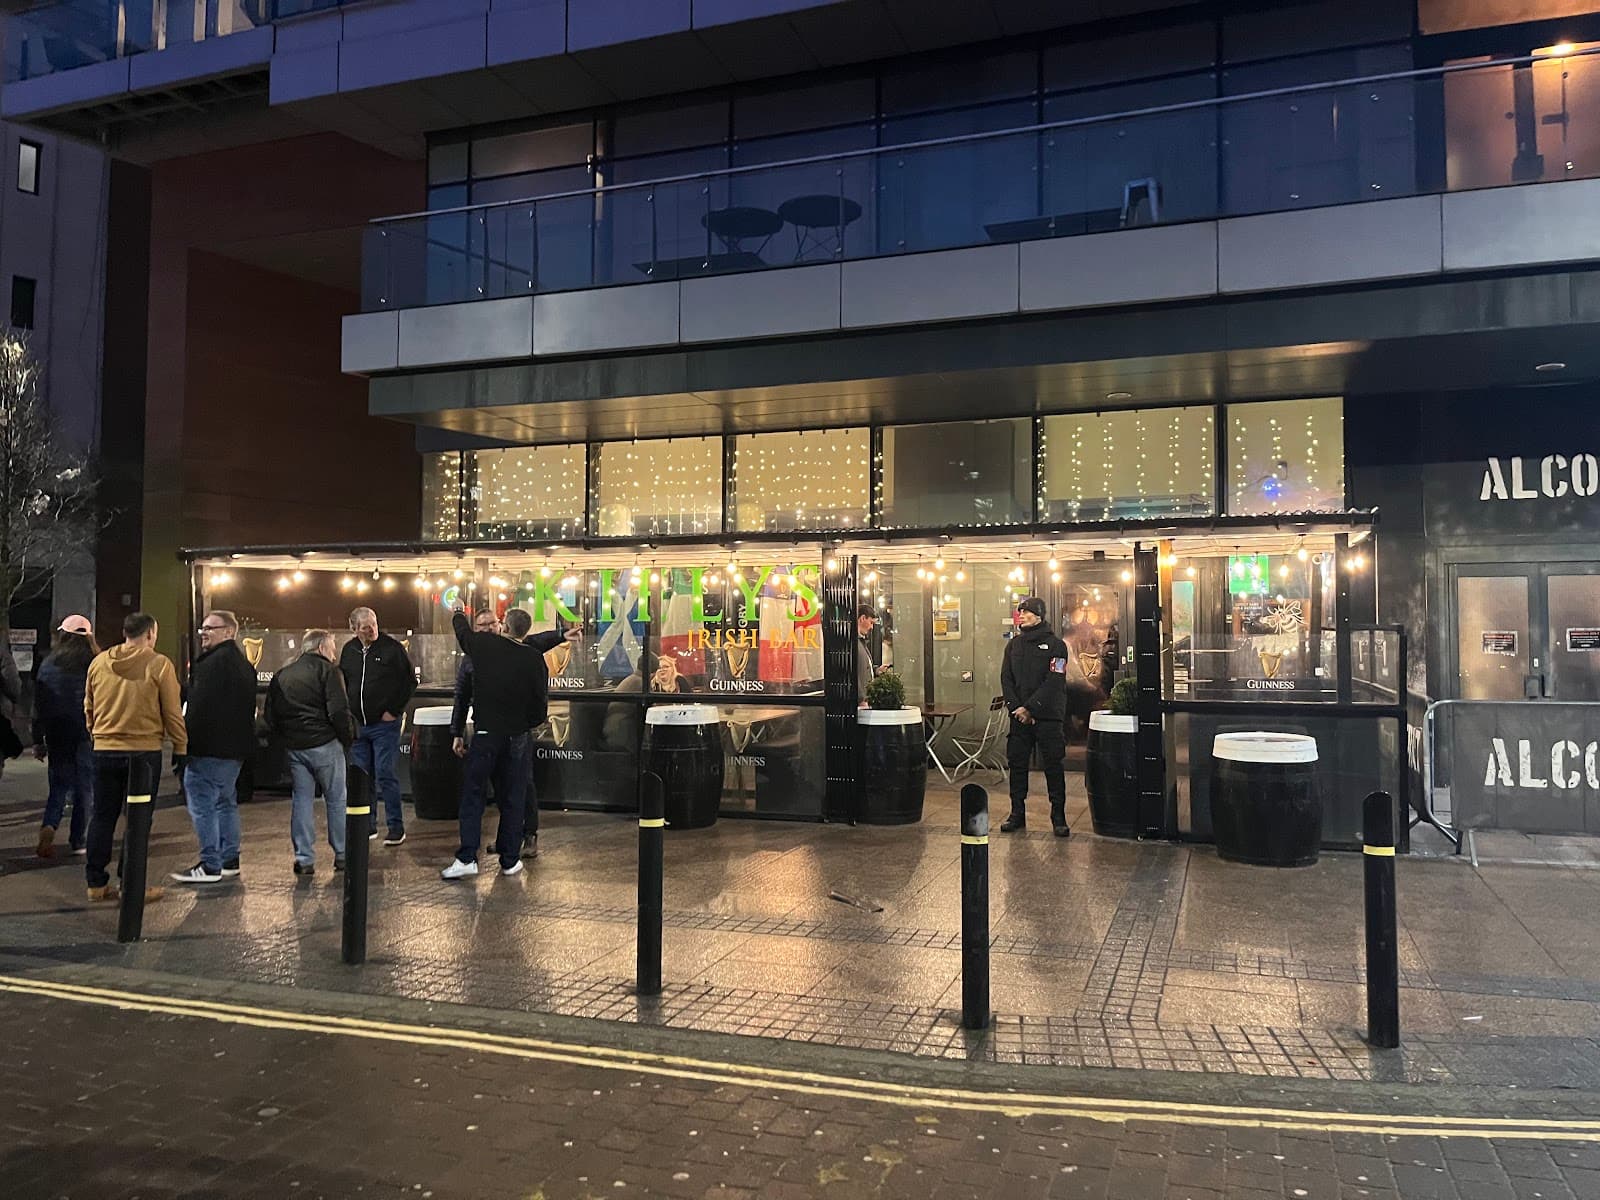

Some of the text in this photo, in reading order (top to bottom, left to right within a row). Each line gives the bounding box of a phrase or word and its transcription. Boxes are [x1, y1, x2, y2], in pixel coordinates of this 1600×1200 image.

[687, 628, 820, 649] IRISH BAR
[547, 677, 585, 688] INNESS
[709, 678, 764, 691] GUINNESS
[1246, 679, 1295, 690] GUINNESS
[536, 747, 584, 760] GUINNESS
[727, 756, 766, 767] INNESS
